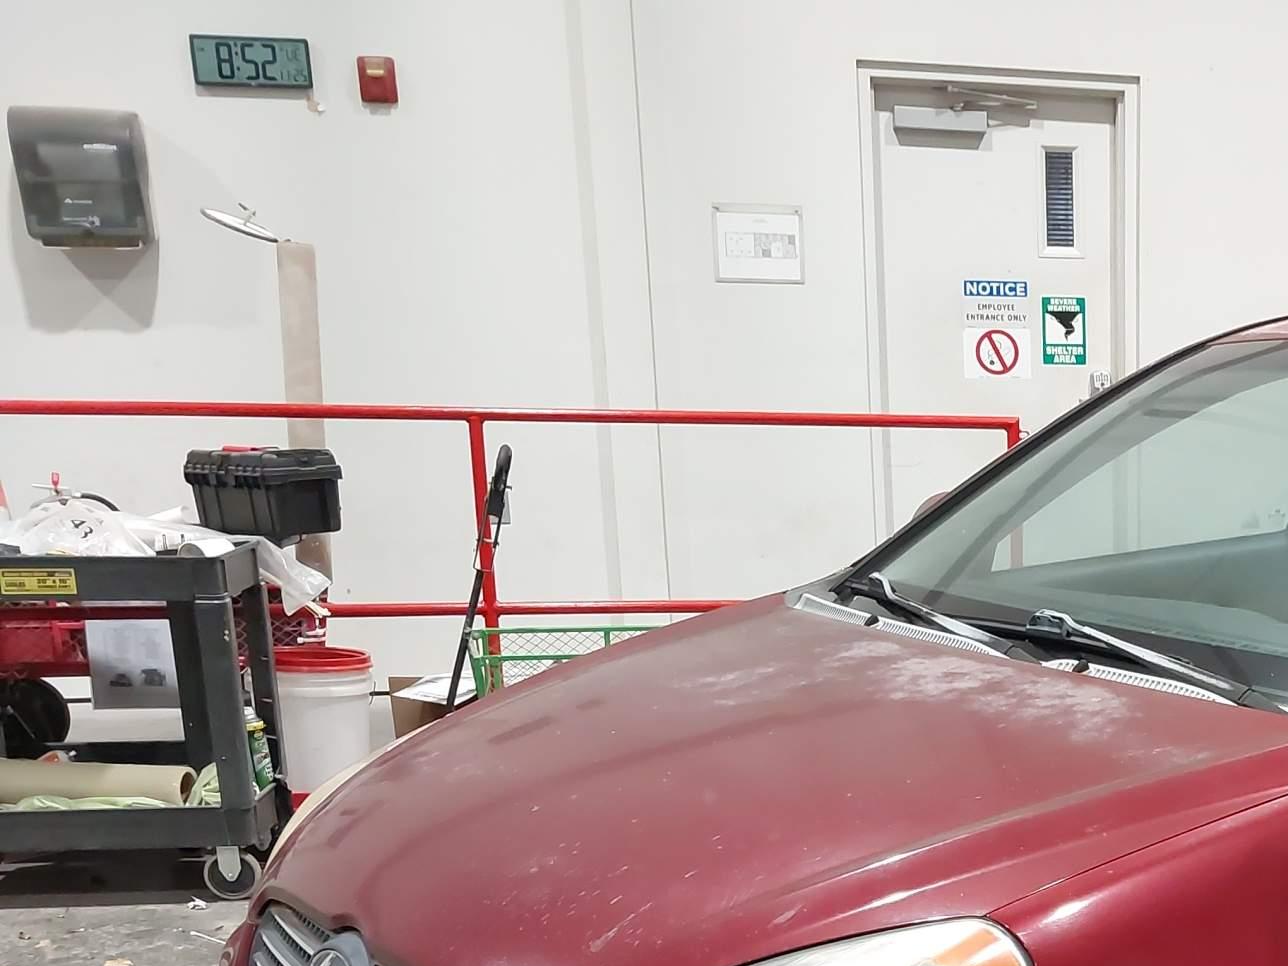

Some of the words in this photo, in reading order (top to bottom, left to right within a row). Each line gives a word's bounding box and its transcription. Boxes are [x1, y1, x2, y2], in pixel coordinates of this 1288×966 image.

[215, 41, 278, 80] 8:52
[965, 281, 1026, 297] NOTICE
[977, 303, 1015, 311] EMPLOYEE
[1047, 304, 1080, 312] WEATHER
[966, 313, 1004, 321] ENTRANCE
[1007, 314, 1027, 322] ONLY
[1046, 346, 1083, 355] SHELTER
[1053, 354, 1076, 363] AREA
[71, 519, 94, 539] 43
